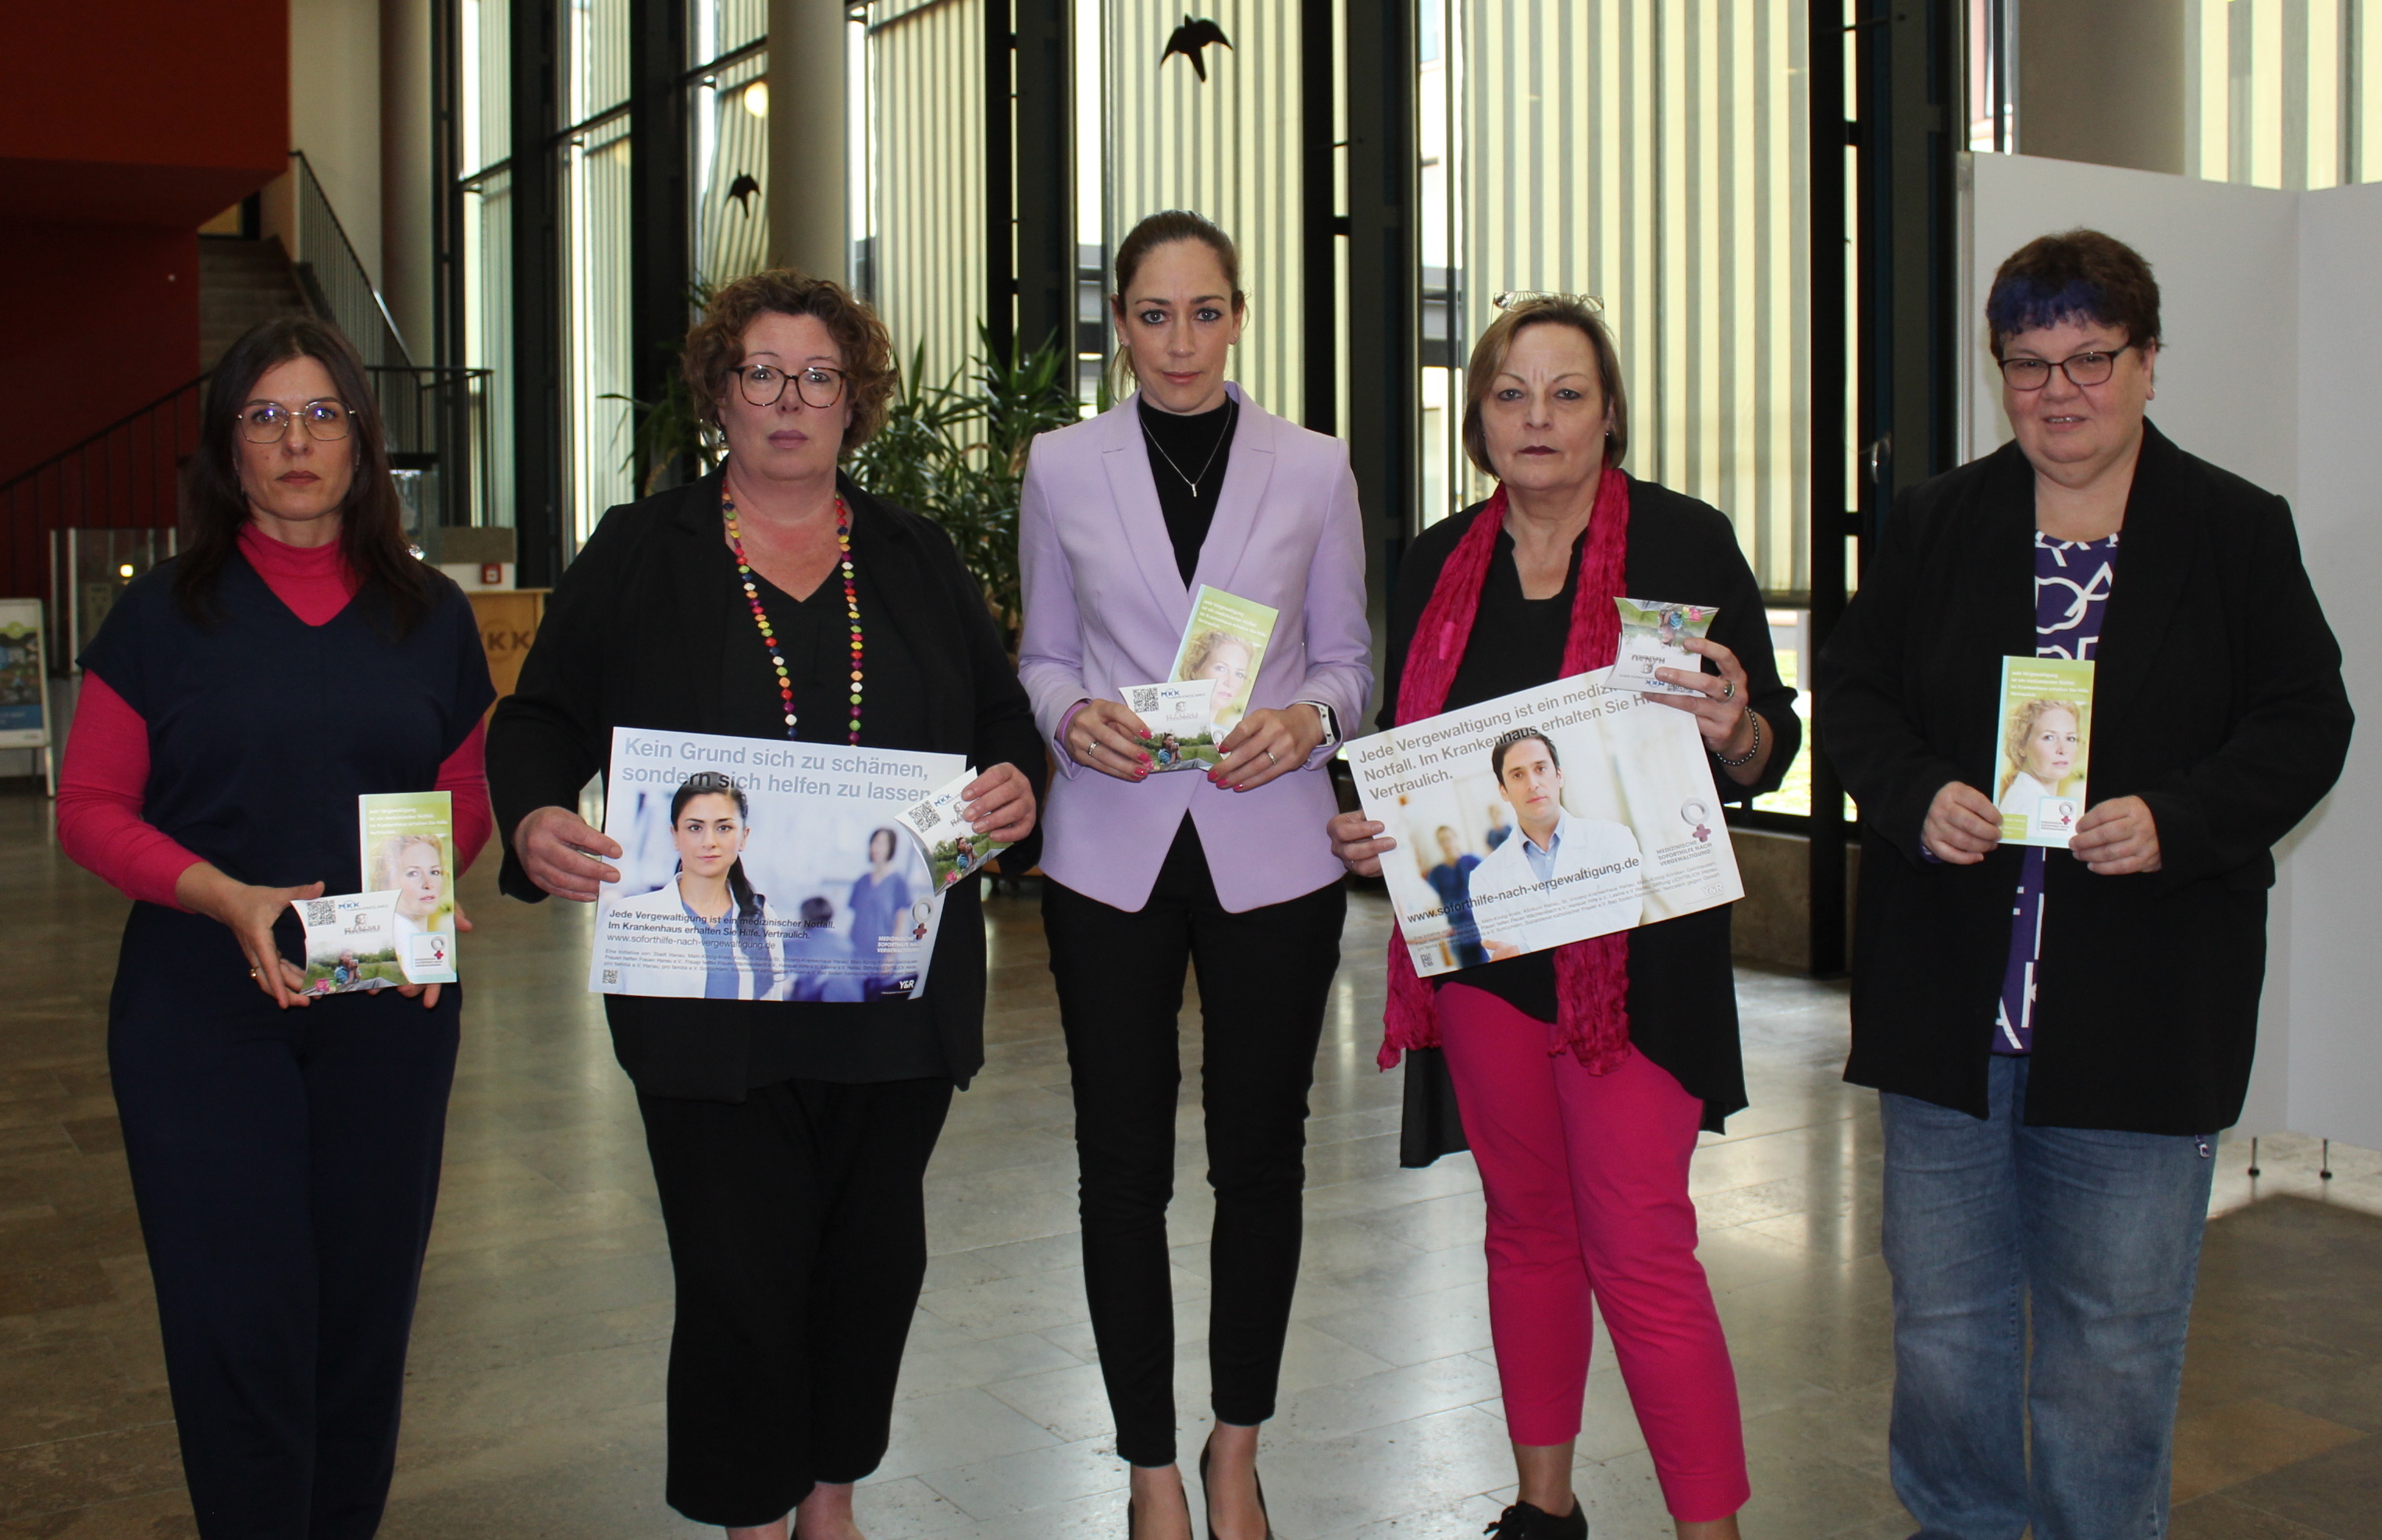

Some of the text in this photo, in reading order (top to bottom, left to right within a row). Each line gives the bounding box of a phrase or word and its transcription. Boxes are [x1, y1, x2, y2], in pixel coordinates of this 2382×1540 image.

[481, 631, 530, 650] KK
[1359, 745, 1394, 763] Jede
[1396, 711, 1511, 752] Vergewaltigung
[1515, 702, 1534, 718] ist
[1537, 698, 1559, 712] ein
[1364, 758, 1416, 782] Notfall.
[1419, 753, 1439, 766] Im
[1441, 725, 1537, 760] Krankenhaus
[1541, 707, 1601, 732] erhalten
[1604, 699, 1629, 714] Sie
[625, 737, 928, 781] Kein Grund sich zu schämen,
[621, 766, 710, 787] sondern
[717, 771, 760, 791] sich
[767, 774, 831, 795] helfen
[836, 783, 860, 798] zu
[1369, 769, 1453, 800] Vertraulich.
[1656, 840, 1698, 854] MEDIZINISCHE
[1658, 842, 1713, 860] SOFORTHILFE NACH
[1660, 849, 1711, 866] VERGEWALTIGUNG
[1407, 857, 1640, 923] www.soforthilfe-nach-vergewaltigung.de
[1704, 883, 1724, 895] Y&R
[609, 909, 632, 918] Jede
[636, 911, 707, 924] Vergewaltigung
[710, 915, 721, 923] ist
[739, 917, 801, 927] medizinischer
[803, 919, 835, 929] Notfall.
[608, 921, 810, 939] Im Krankenhaus erhalten Sie Hilfe. Vertraulich.
[607, 934, 776, 950] www.soforthilfe-nach-vergewaltigung.de
